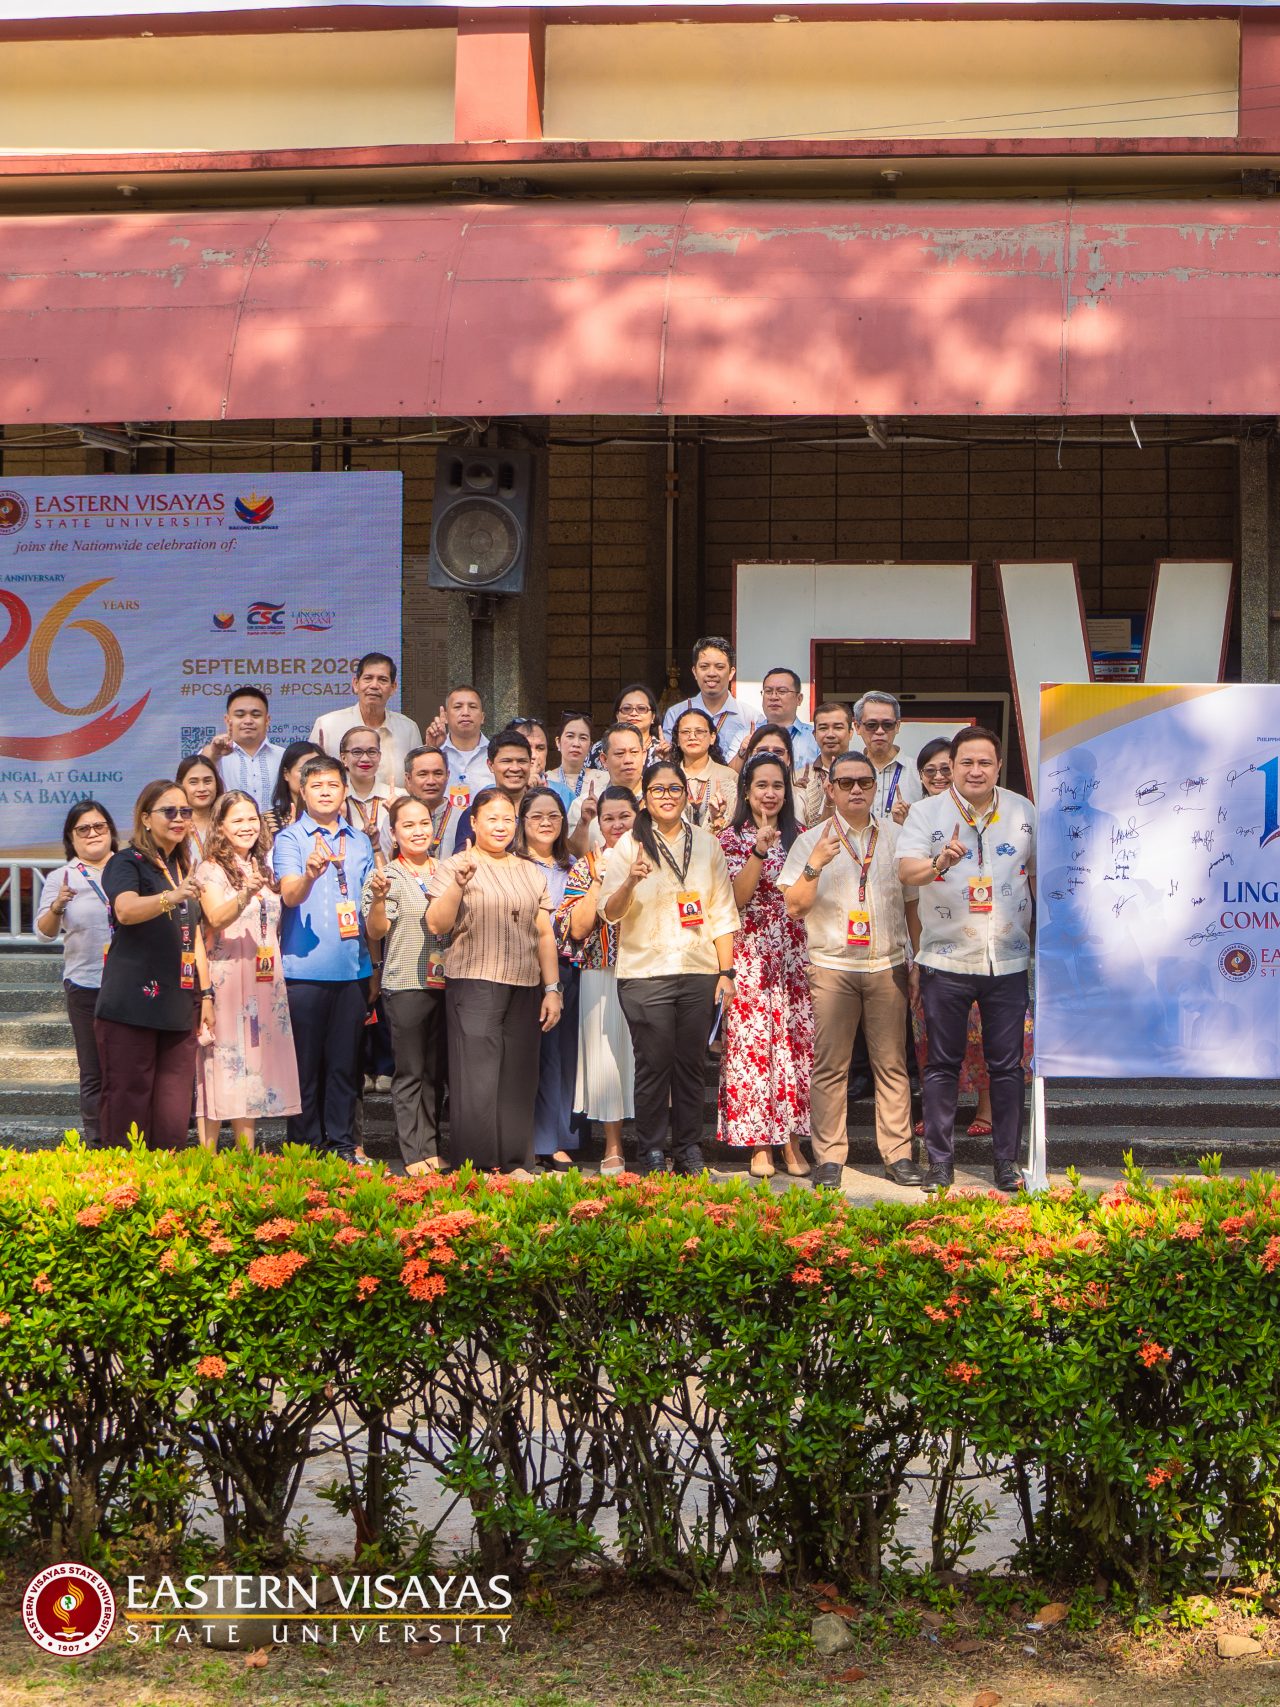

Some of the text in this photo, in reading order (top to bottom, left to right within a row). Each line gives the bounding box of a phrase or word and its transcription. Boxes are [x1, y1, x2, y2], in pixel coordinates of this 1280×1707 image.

[35, 493, 225, 512] EASTERN VISAYAS
[34, 517, 225, 529] STATE UNIVERSITY
[13, 541, 46, 555] joins
[49, 540, 68, 552] the
[72, 539, 142, 552] Nationwide
[146, 538, 216, 551] celebration
[5, 574, 66, 582] ANNIVERSARY
[103, 600, 140, 610] YEARS
[246, 610, 285, 625] CSC
[182, 658, 361, 676] SEPTEMBER 2026
[280, 683, 358, 696] #PCSA12
[47, 771, 64, 782] AT
[68, 770, 124, 782] GALING
[14, 790, 34, 804] SA
[39, 788, 95, 804] BAYAN
